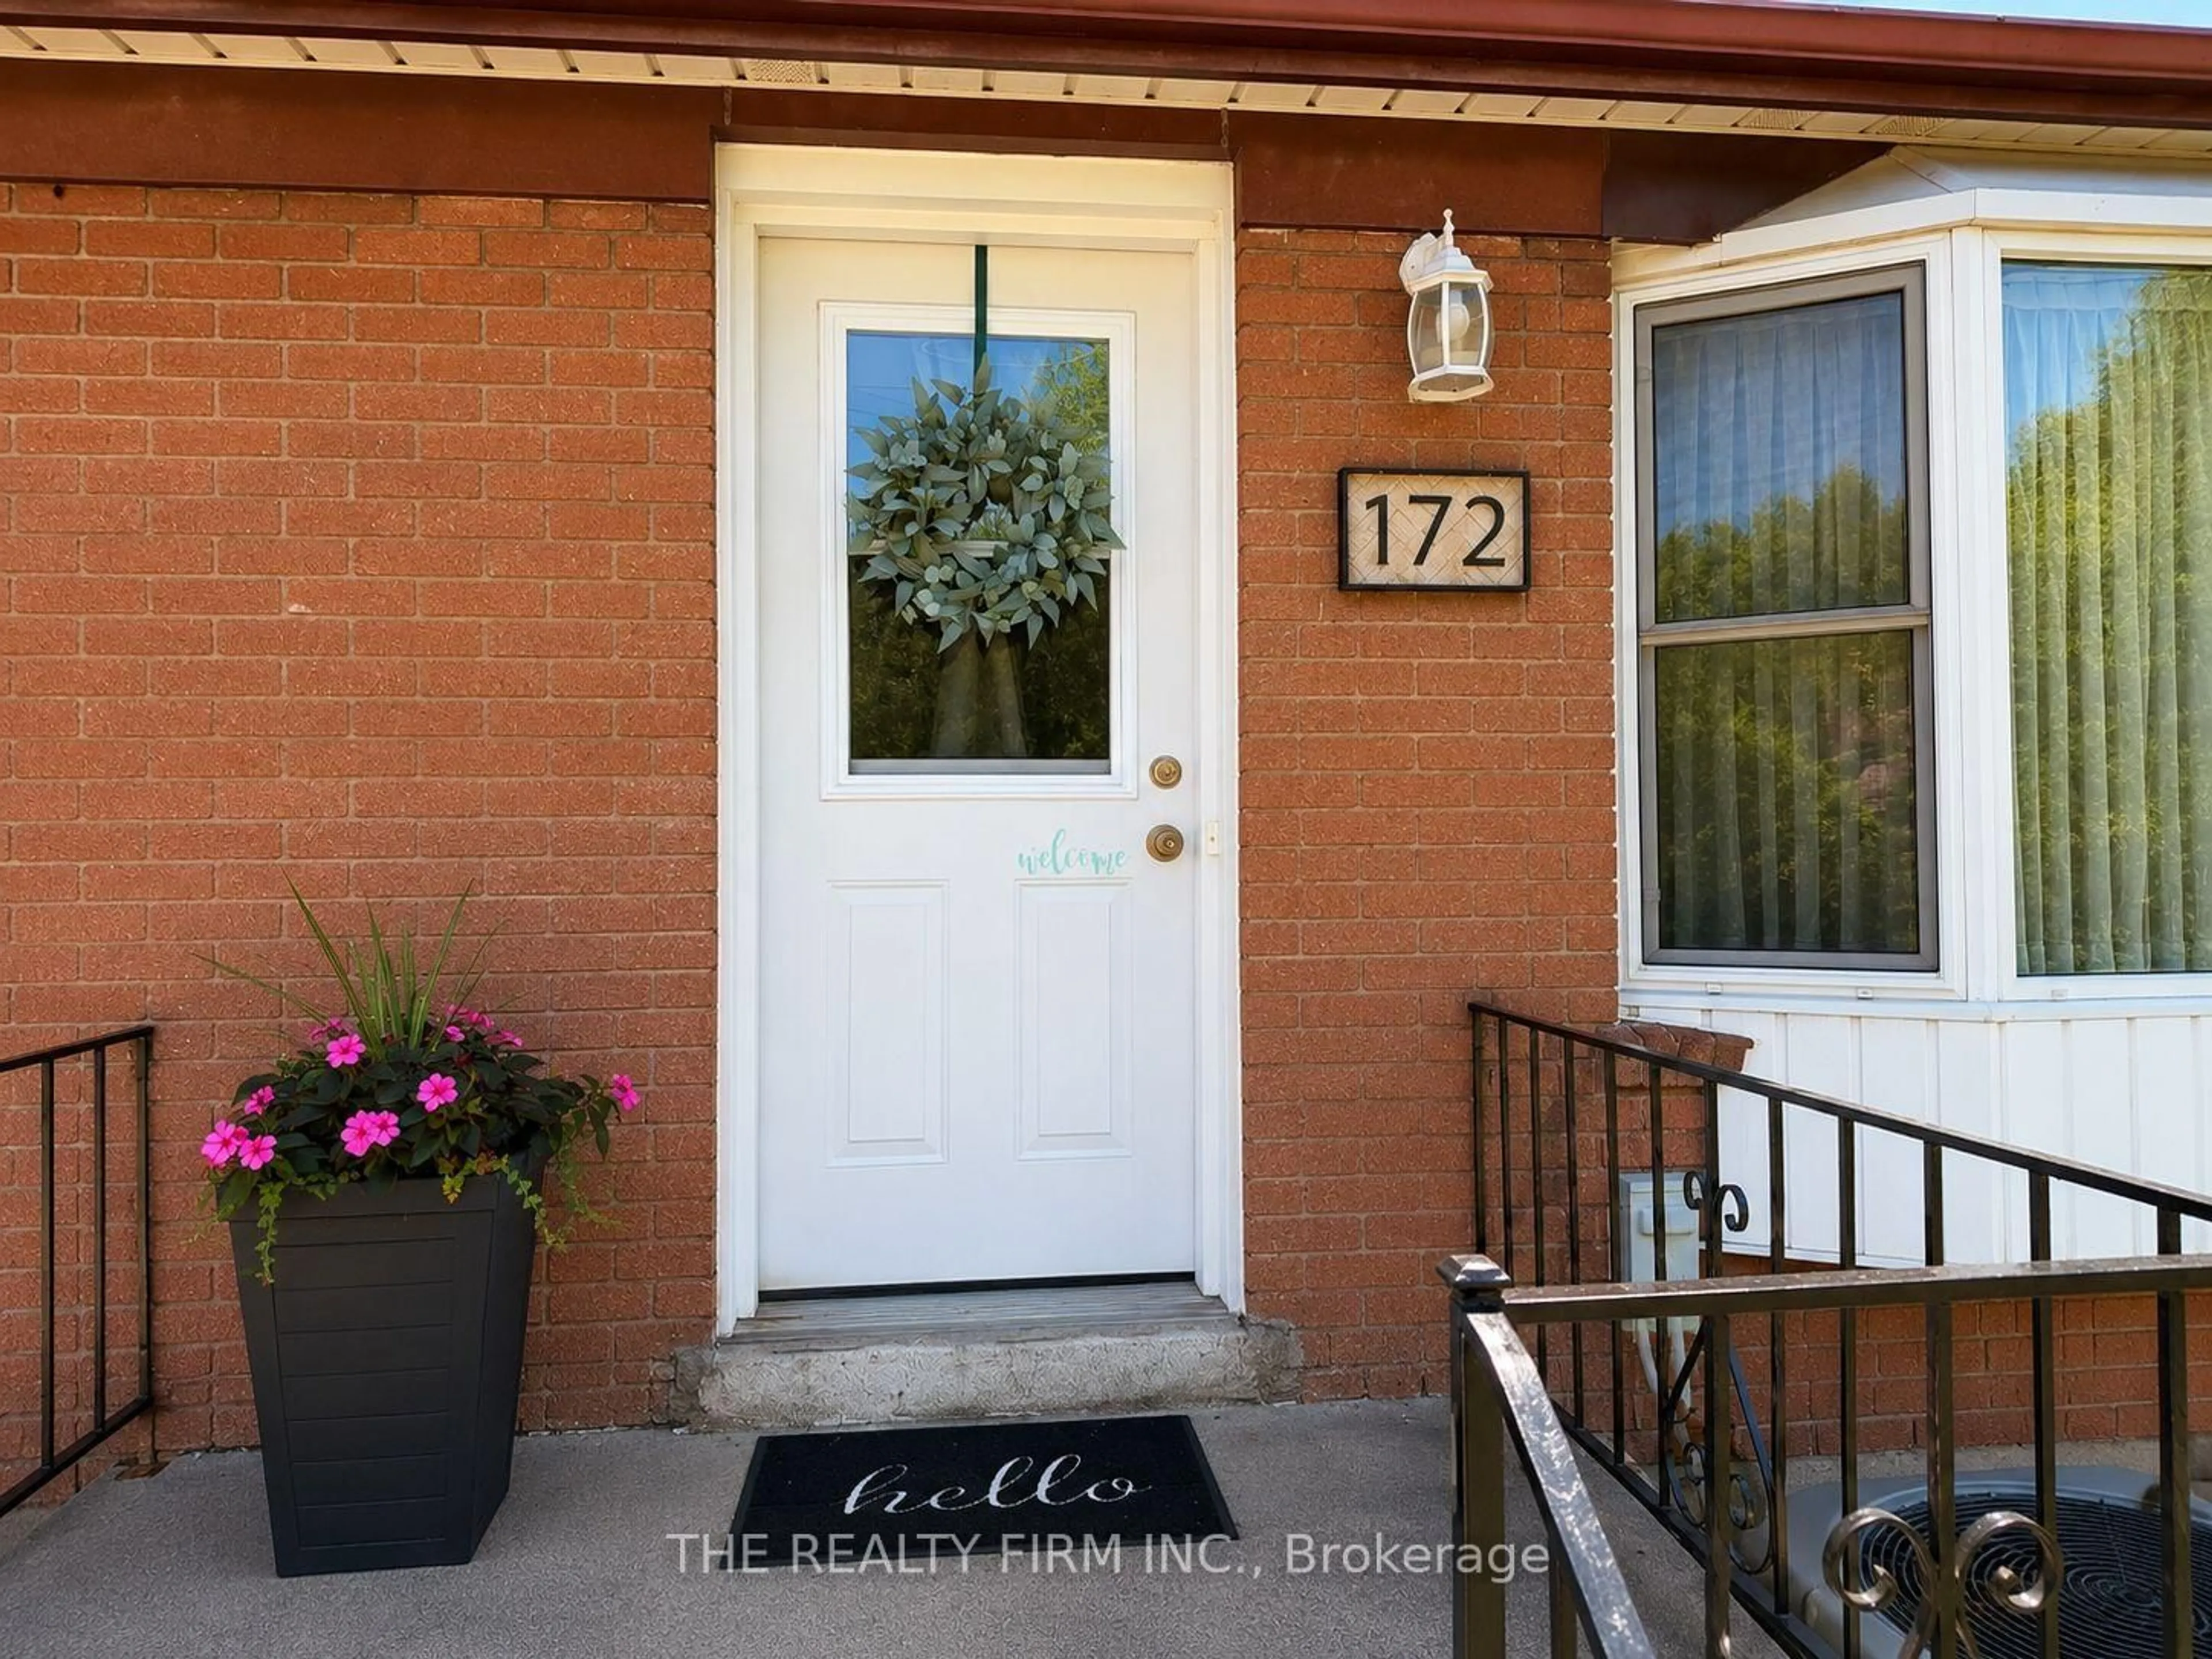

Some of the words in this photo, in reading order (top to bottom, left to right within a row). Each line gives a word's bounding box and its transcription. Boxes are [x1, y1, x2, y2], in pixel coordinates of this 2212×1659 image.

[1365, 494, 1506, 567] 172
[1017, 828, 1127, 875] welcome
[841, 1453, 1152, 1515] hello
